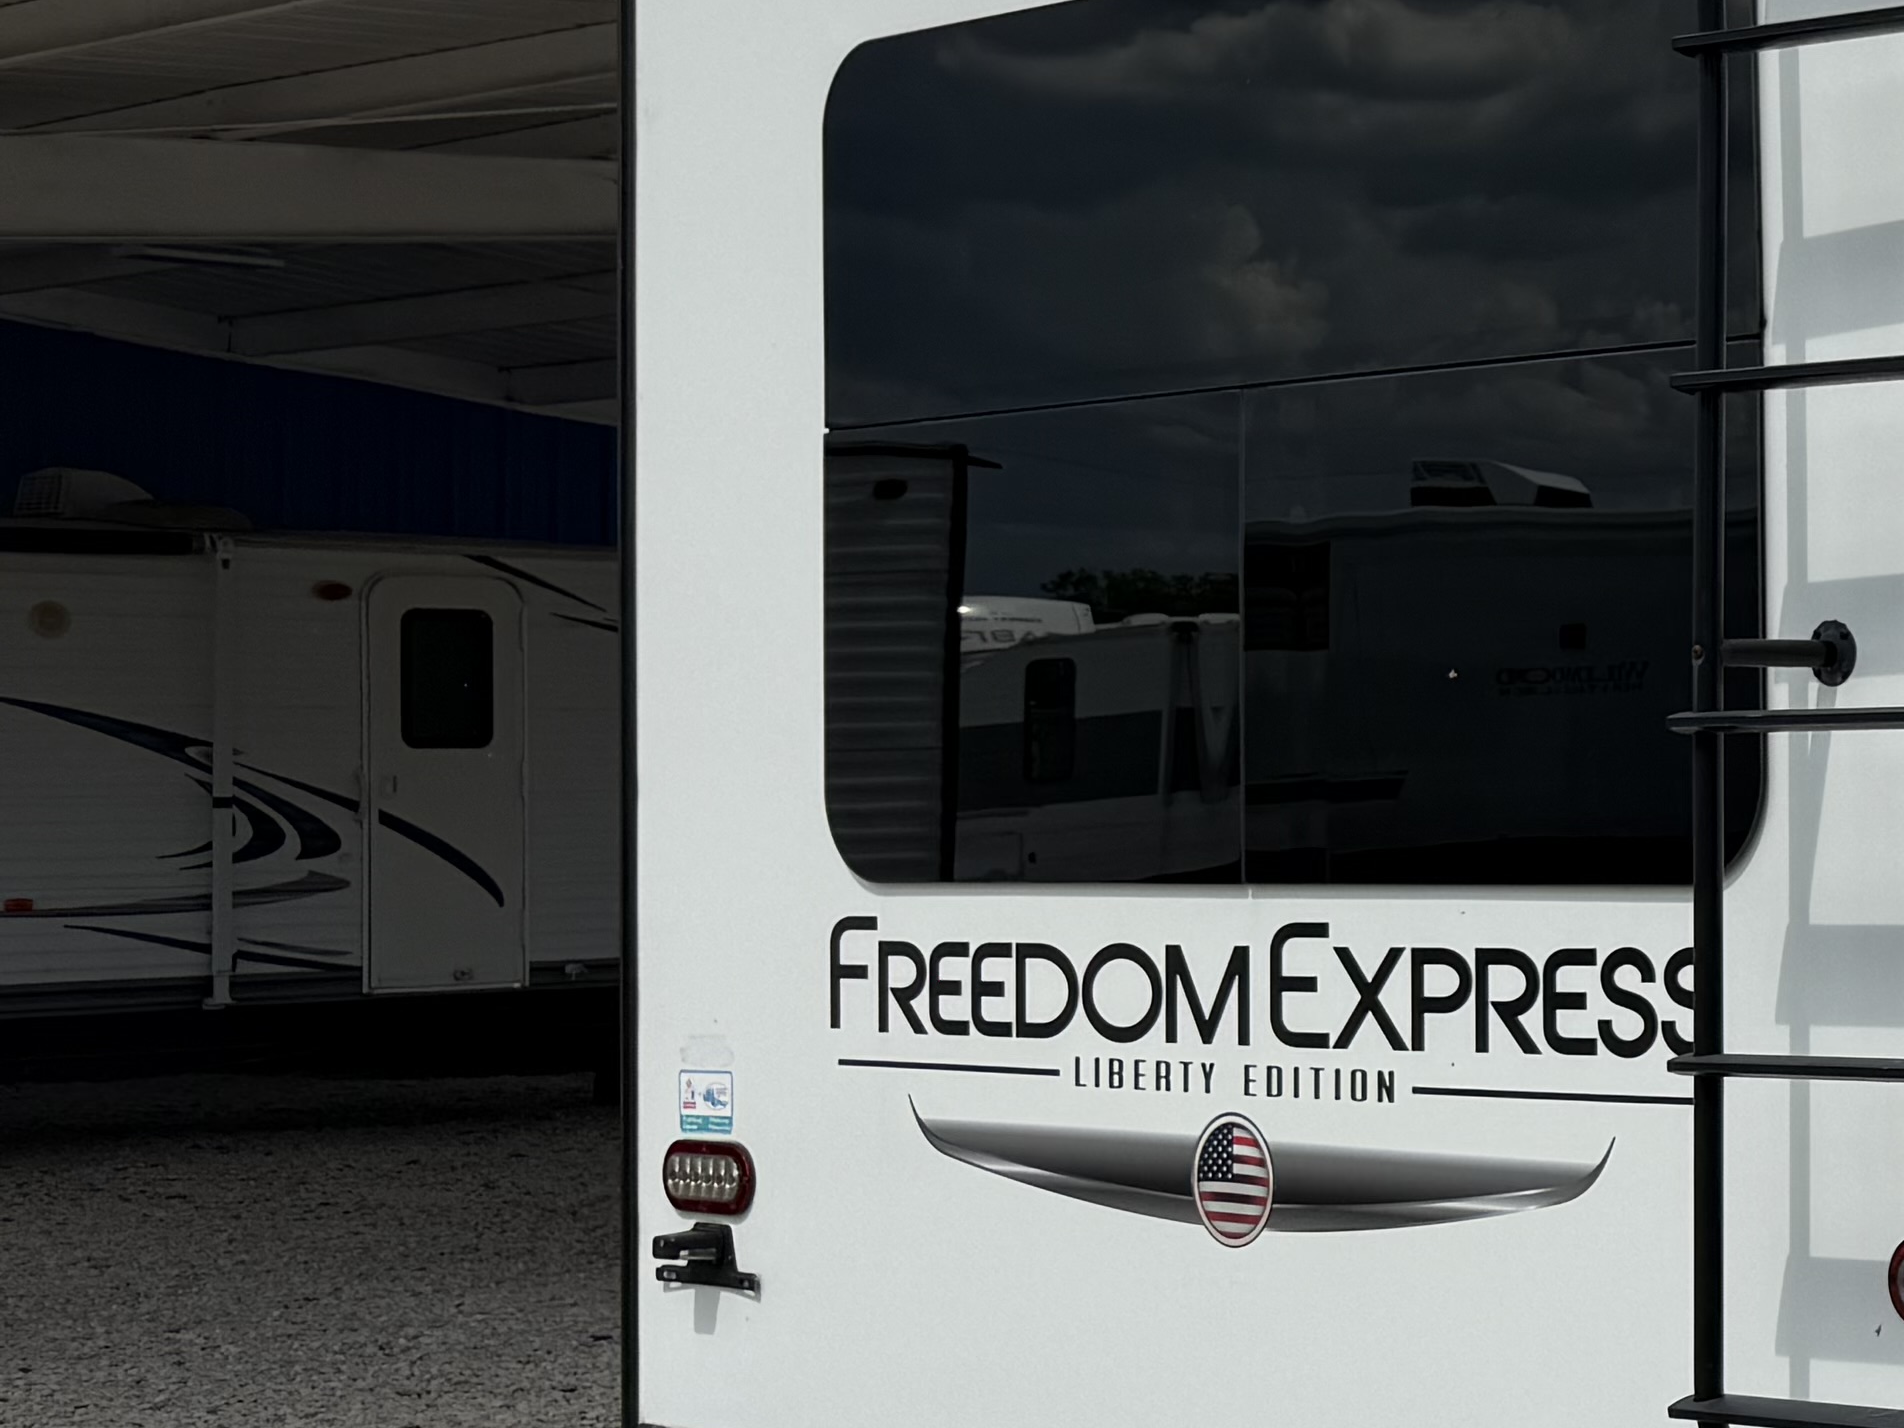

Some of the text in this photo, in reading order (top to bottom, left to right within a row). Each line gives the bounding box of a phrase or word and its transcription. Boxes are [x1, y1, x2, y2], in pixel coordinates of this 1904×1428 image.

[829, 915, 1251, 1047] FREEDOM
[1074, 1055, 1396, 1104] LIBERTY EDITION
